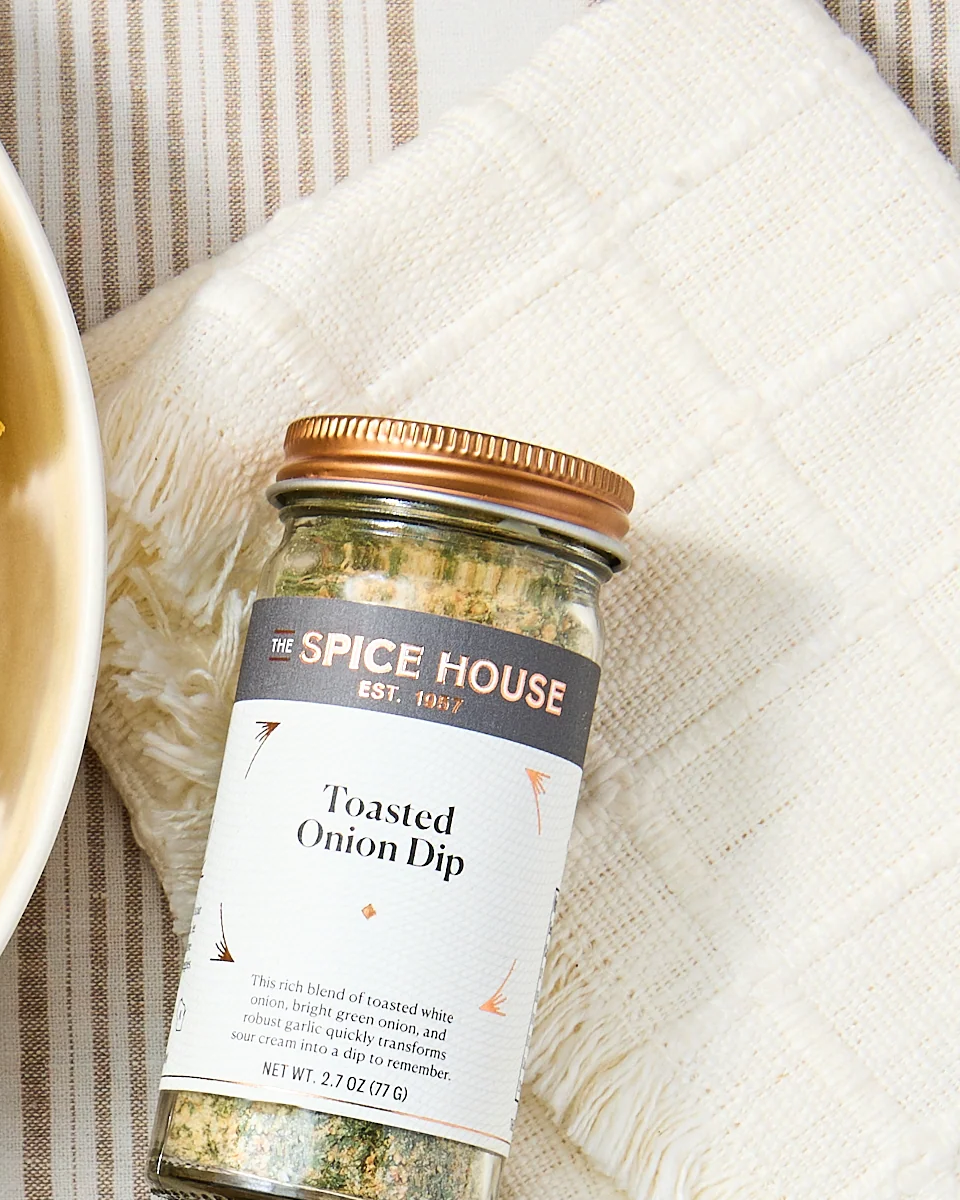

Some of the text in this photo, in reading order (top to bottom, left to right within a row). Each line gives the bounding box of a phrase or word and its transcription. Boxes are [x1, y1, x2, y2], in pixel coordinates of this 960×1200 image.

[271, 629, 568, 716] THE SPICE HOUSE
[358, 679, 465, 714] EST. 1957
[323, 784, 455, 835] Toasted
[297, 818, 465, 882] Onion Dip
[250, 995, 447, 1041] onion, bright green onion, and
[251, 973, 454, 1024] This rich blend of toasted white
[230, 1030, 451, 1081] sour cream into a dip to remember.
[243, 1012, 447, 1061] robust garlic quickly transforms
[262, 1061, 408, 1103] NET WT. 2.7 OZ (77 G)
